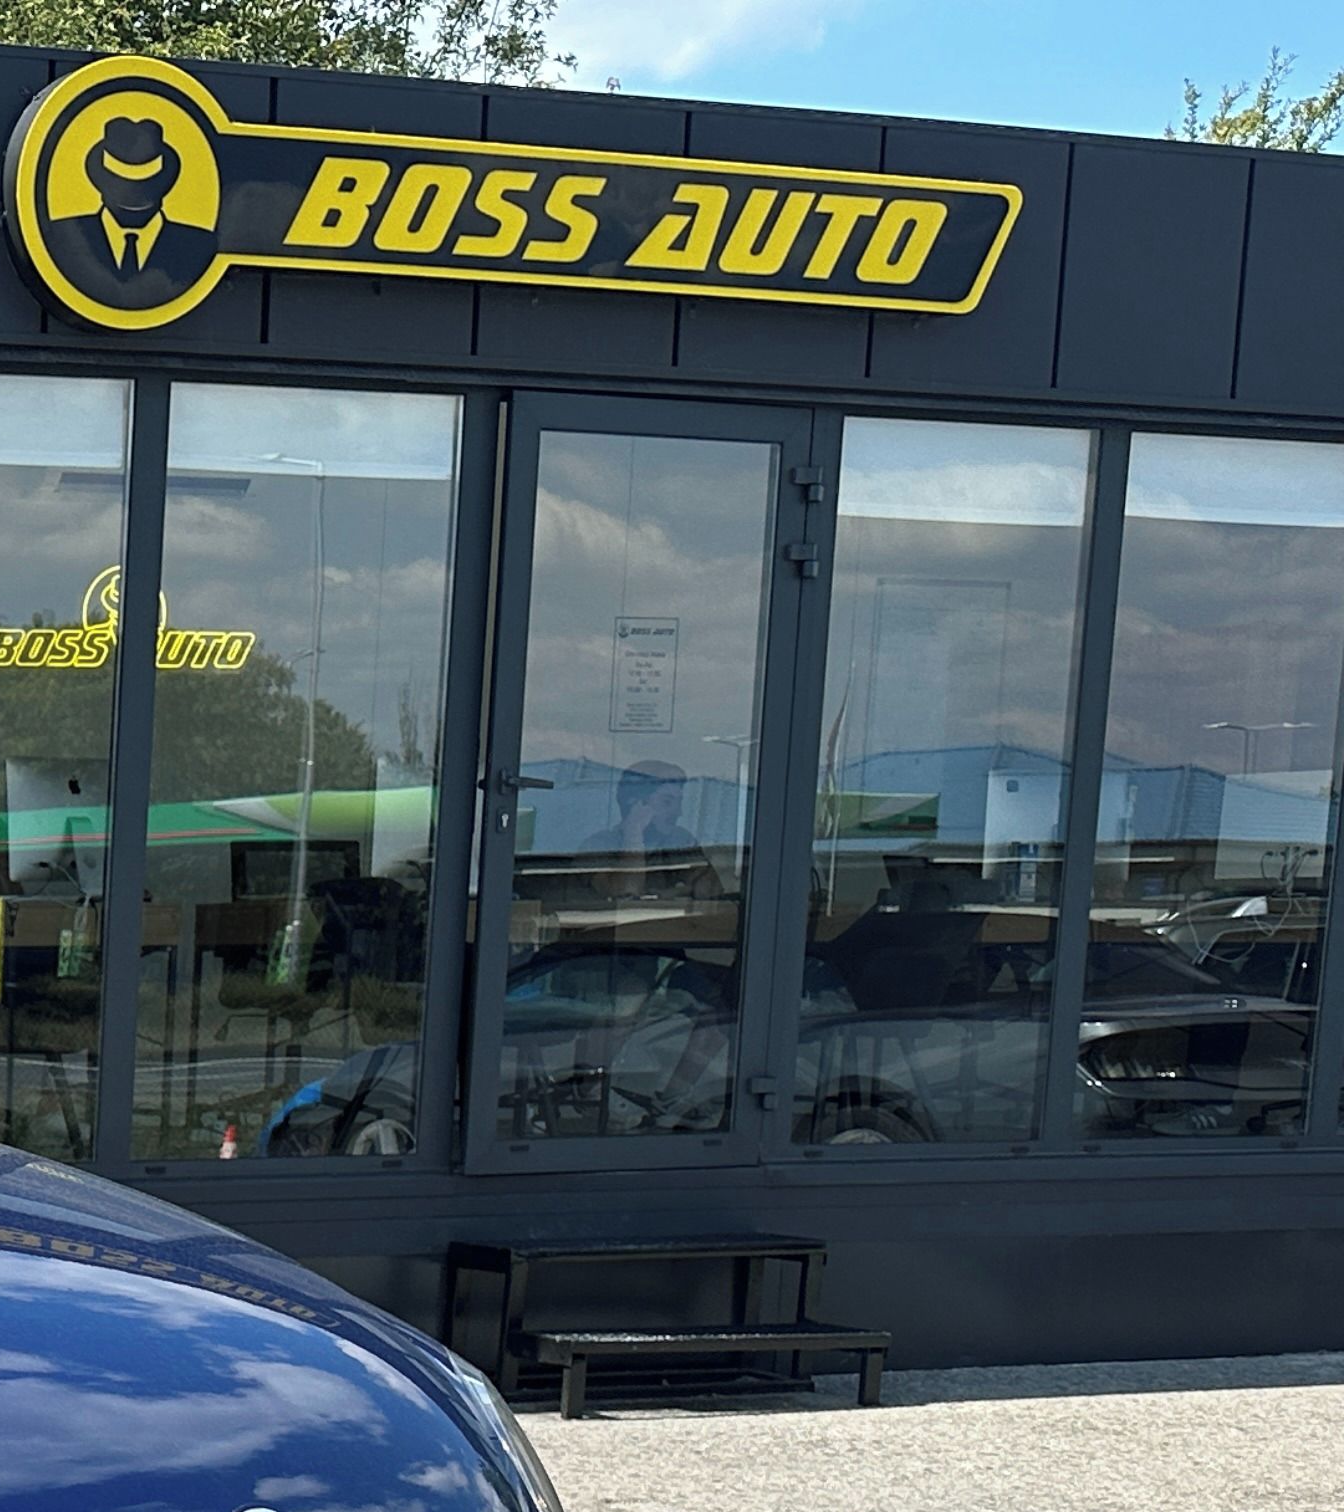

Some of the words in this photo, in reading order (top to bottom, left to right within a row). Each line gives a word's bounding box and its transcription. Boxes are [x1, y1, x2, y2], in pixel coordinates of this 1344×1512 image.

[283, 157, 607, 263] BOSS
[624, 183, 949, 285] AUTO
[155, 630, 256, 669] UTO
